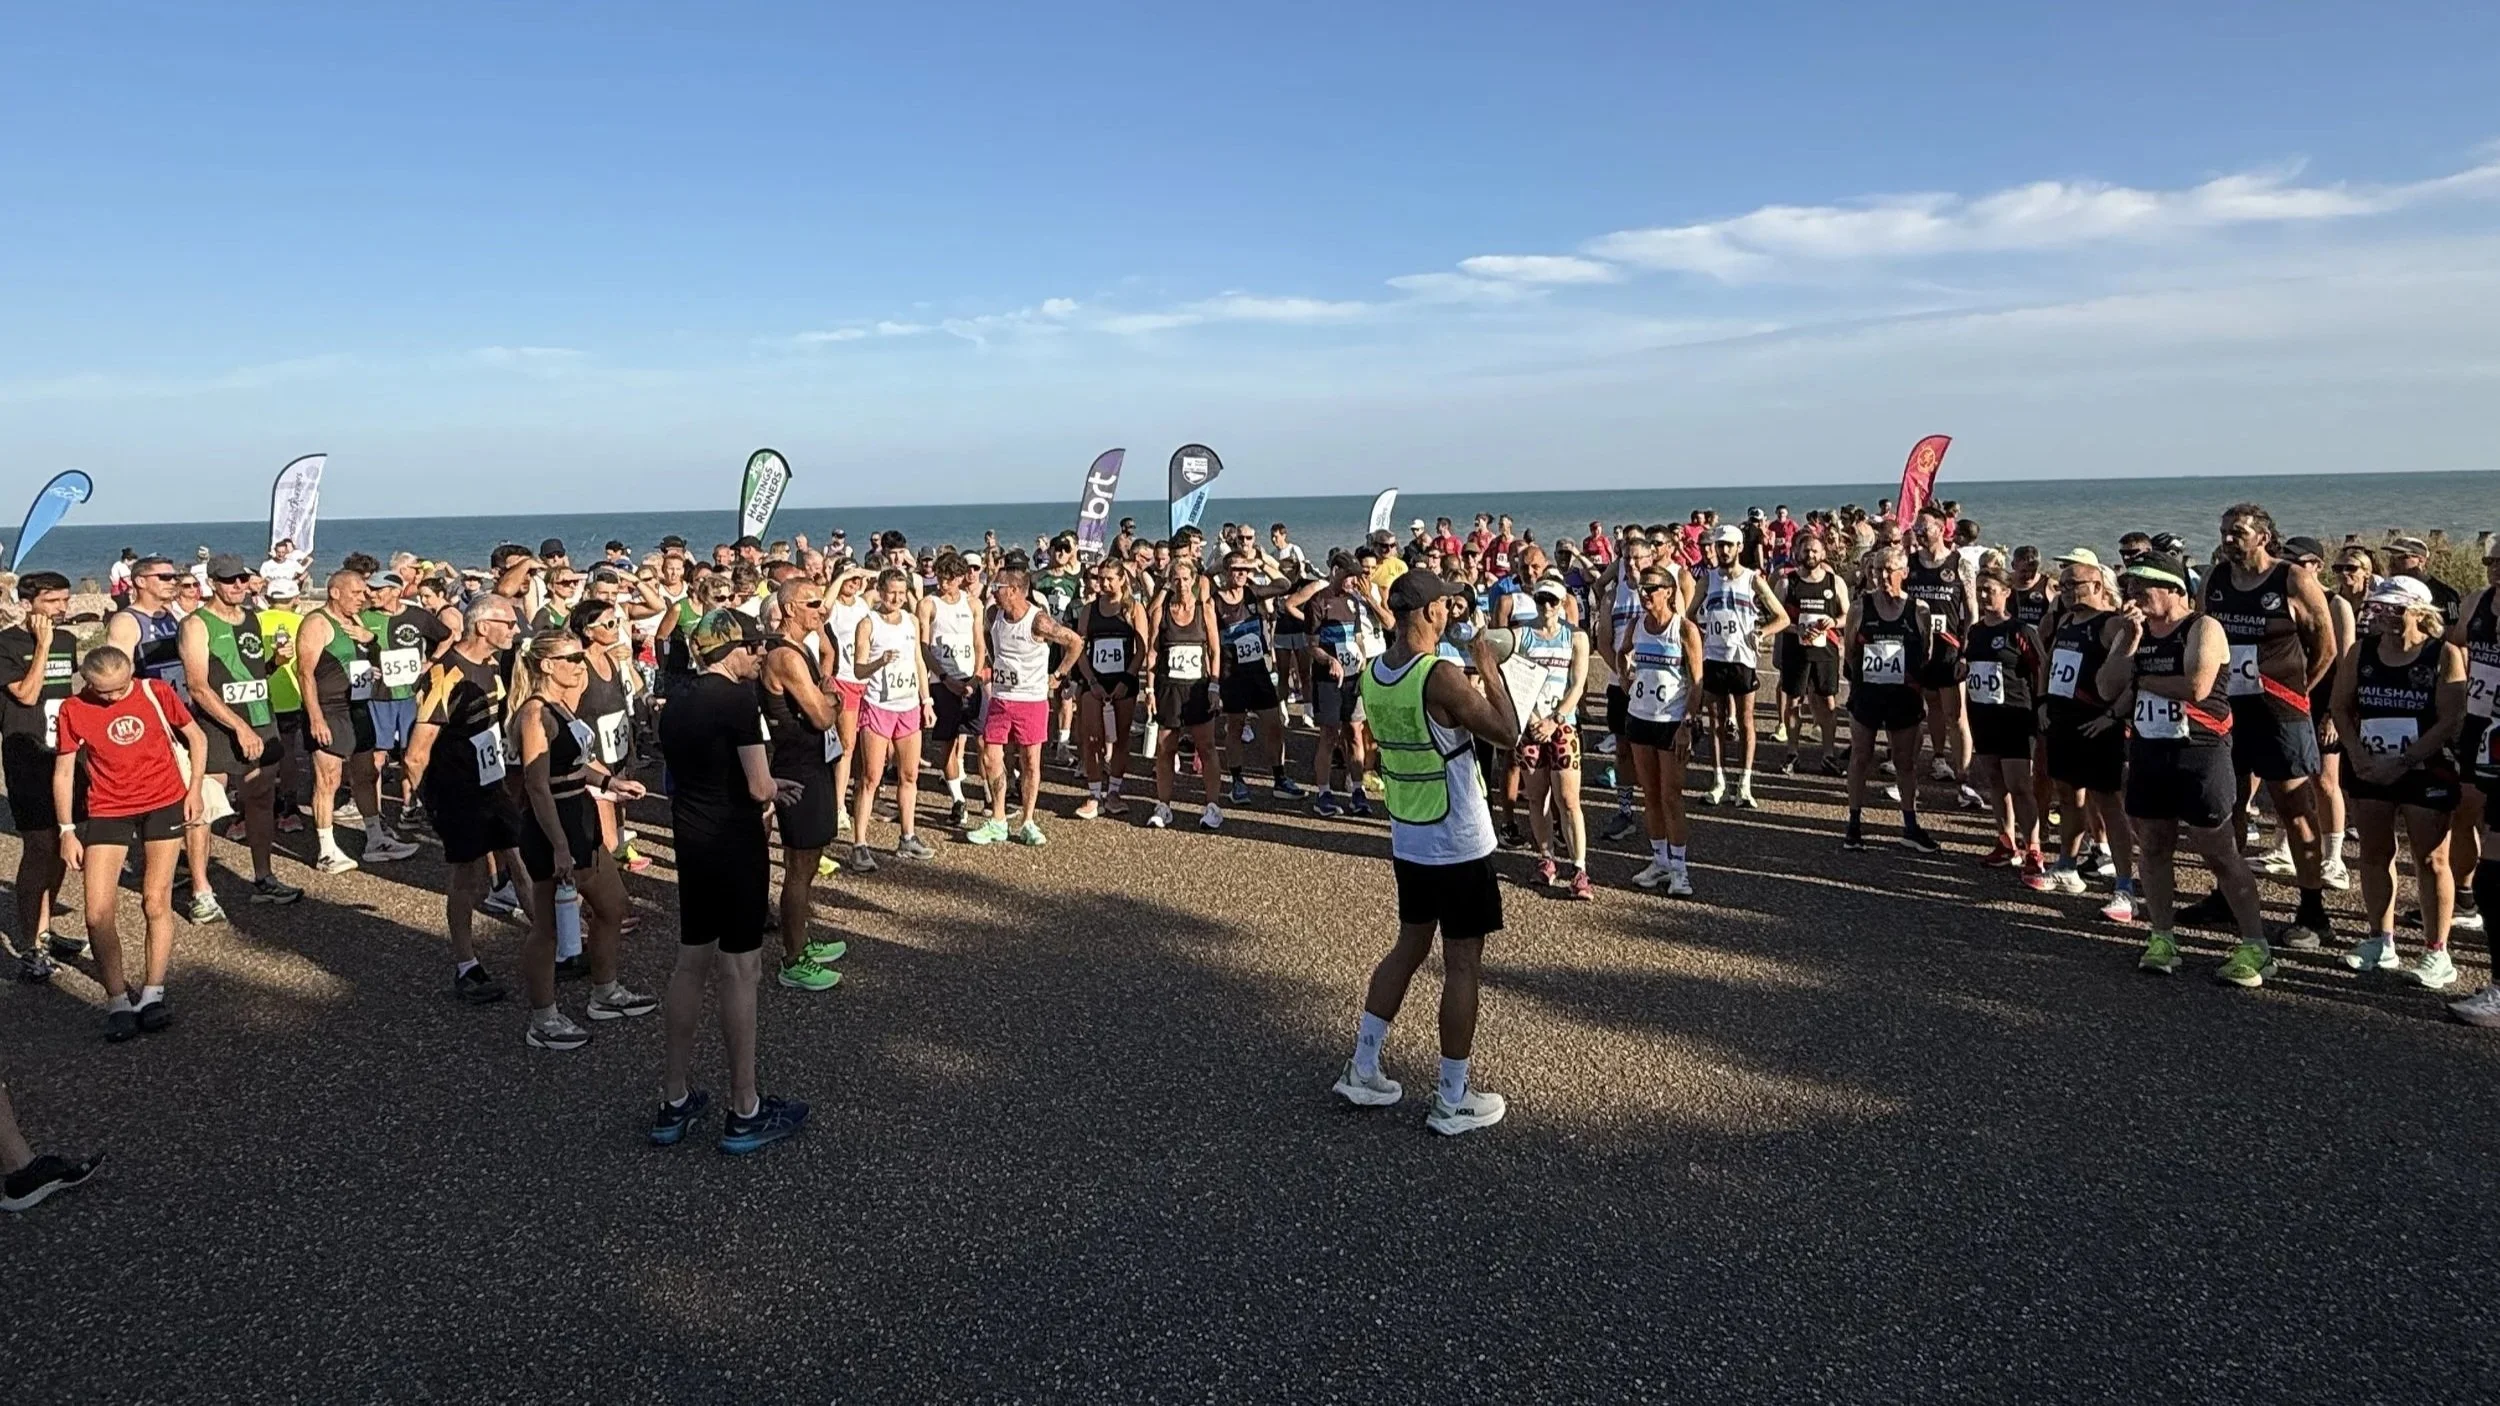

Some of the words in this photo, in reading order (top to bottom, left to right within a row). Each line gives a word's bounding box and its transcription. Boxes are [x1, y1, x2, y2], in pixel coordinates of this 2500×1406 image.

[747, 467, 773, 519] HASTINGS
[756, 471, 782, 524] RUNNERS
[1081, 472, 1117, 520] brt
[1908, 585, 1954, 594] HAILSHAM
[1710, 620, 1737, 635] 10-B
[943, 644, 971, 658] 26-B
[1095, 648, 1122, 664] 12-B
[384, 660, 418, 676] 35-B
[1171, 655, 1199, 672] 12-C
[1864, 656, 1902, 673] 20-A
[2228, 660, 2256, 680] -C
[888, 672, 917, 689] 26-A
[994, 668, 1018, 685] 25-B
[1968, 674, 2000, 691] 20-D
[225, 682, 265, 702] 37-D
[2357, 685, 2428, 701] HAILSHAM
[2136, 700, 2181, 722] 21-B
[2358, 696, 2425, 711] HARRIERS
[480, 745, 501, 769] 13-
